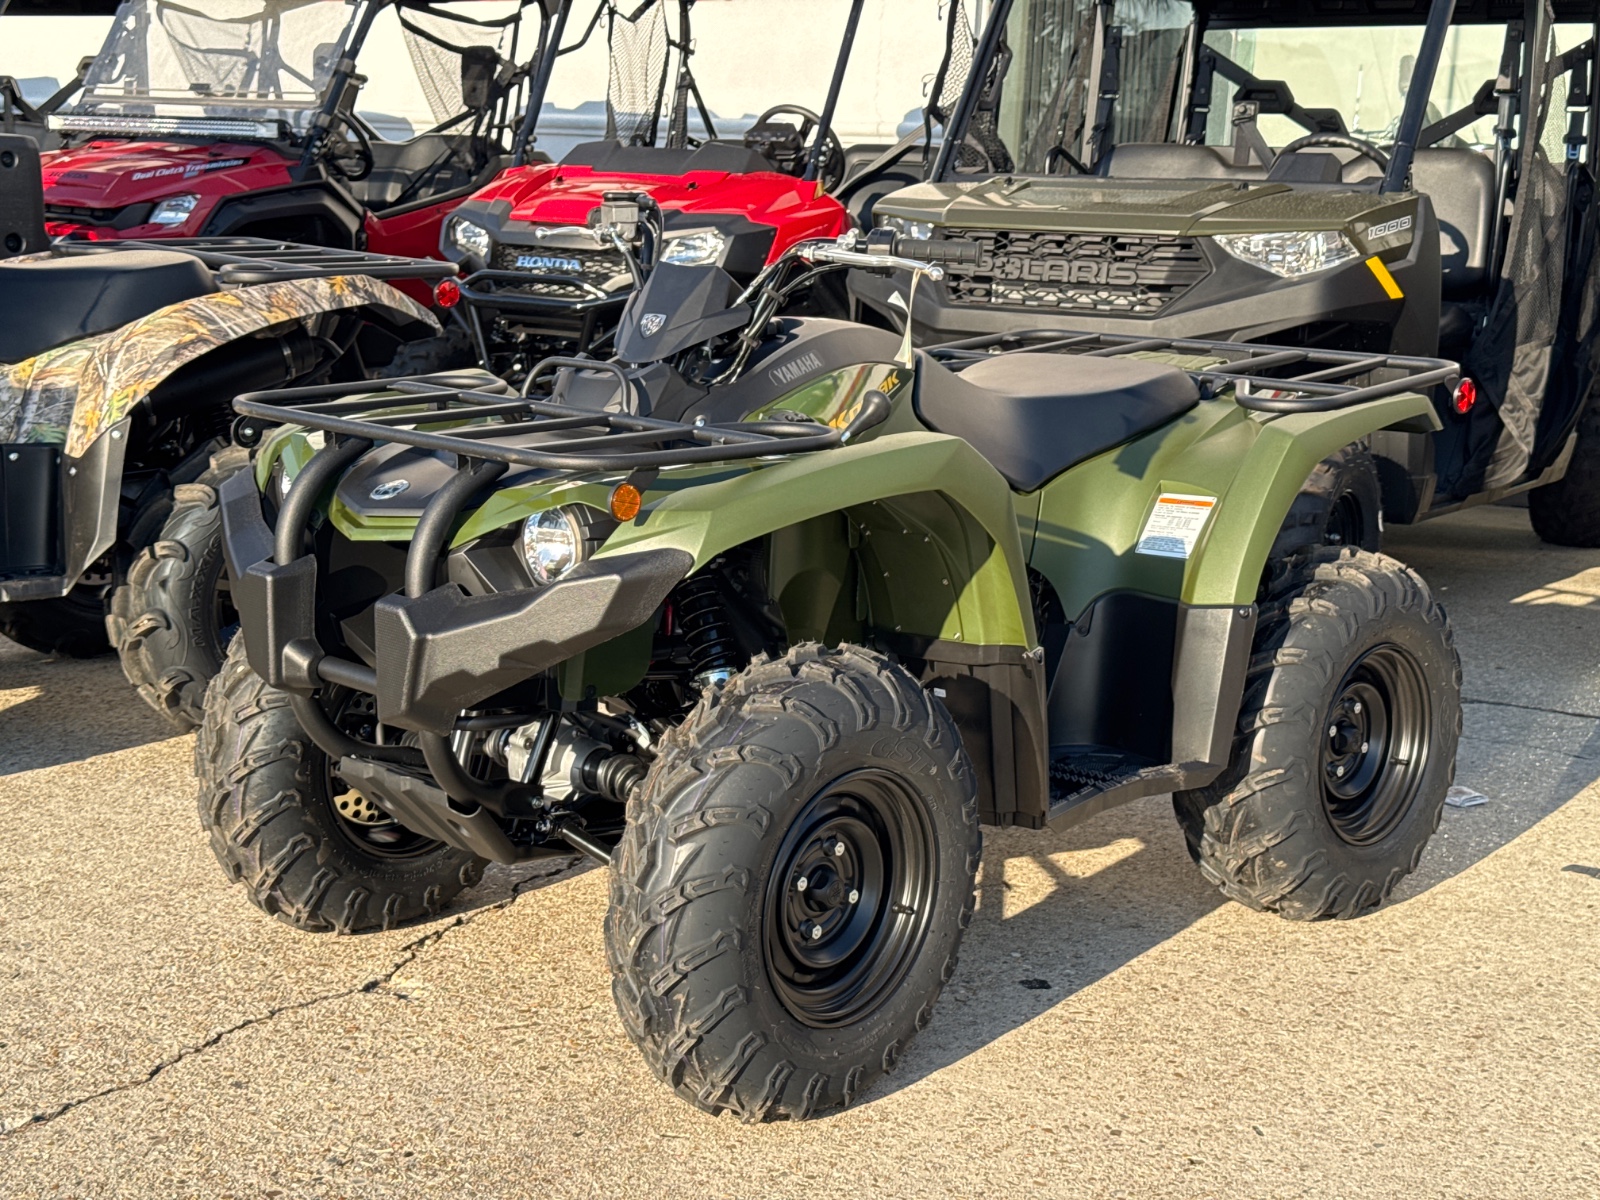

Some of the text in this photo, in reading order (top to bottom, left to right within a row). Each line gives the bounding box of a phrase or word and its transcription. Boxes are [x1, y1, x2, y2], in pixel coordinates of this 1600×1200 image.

[131, 159, 244, 181] Dual Clutch Transmission
[1367, 215, 1413, 241] 1000
[516, 255, 583, 272] HONDA
[967, 256, 1138, 286] POLARIS
[773, 352, 823, 384] YAMAHA
[870, 736, 937, 775] CST
